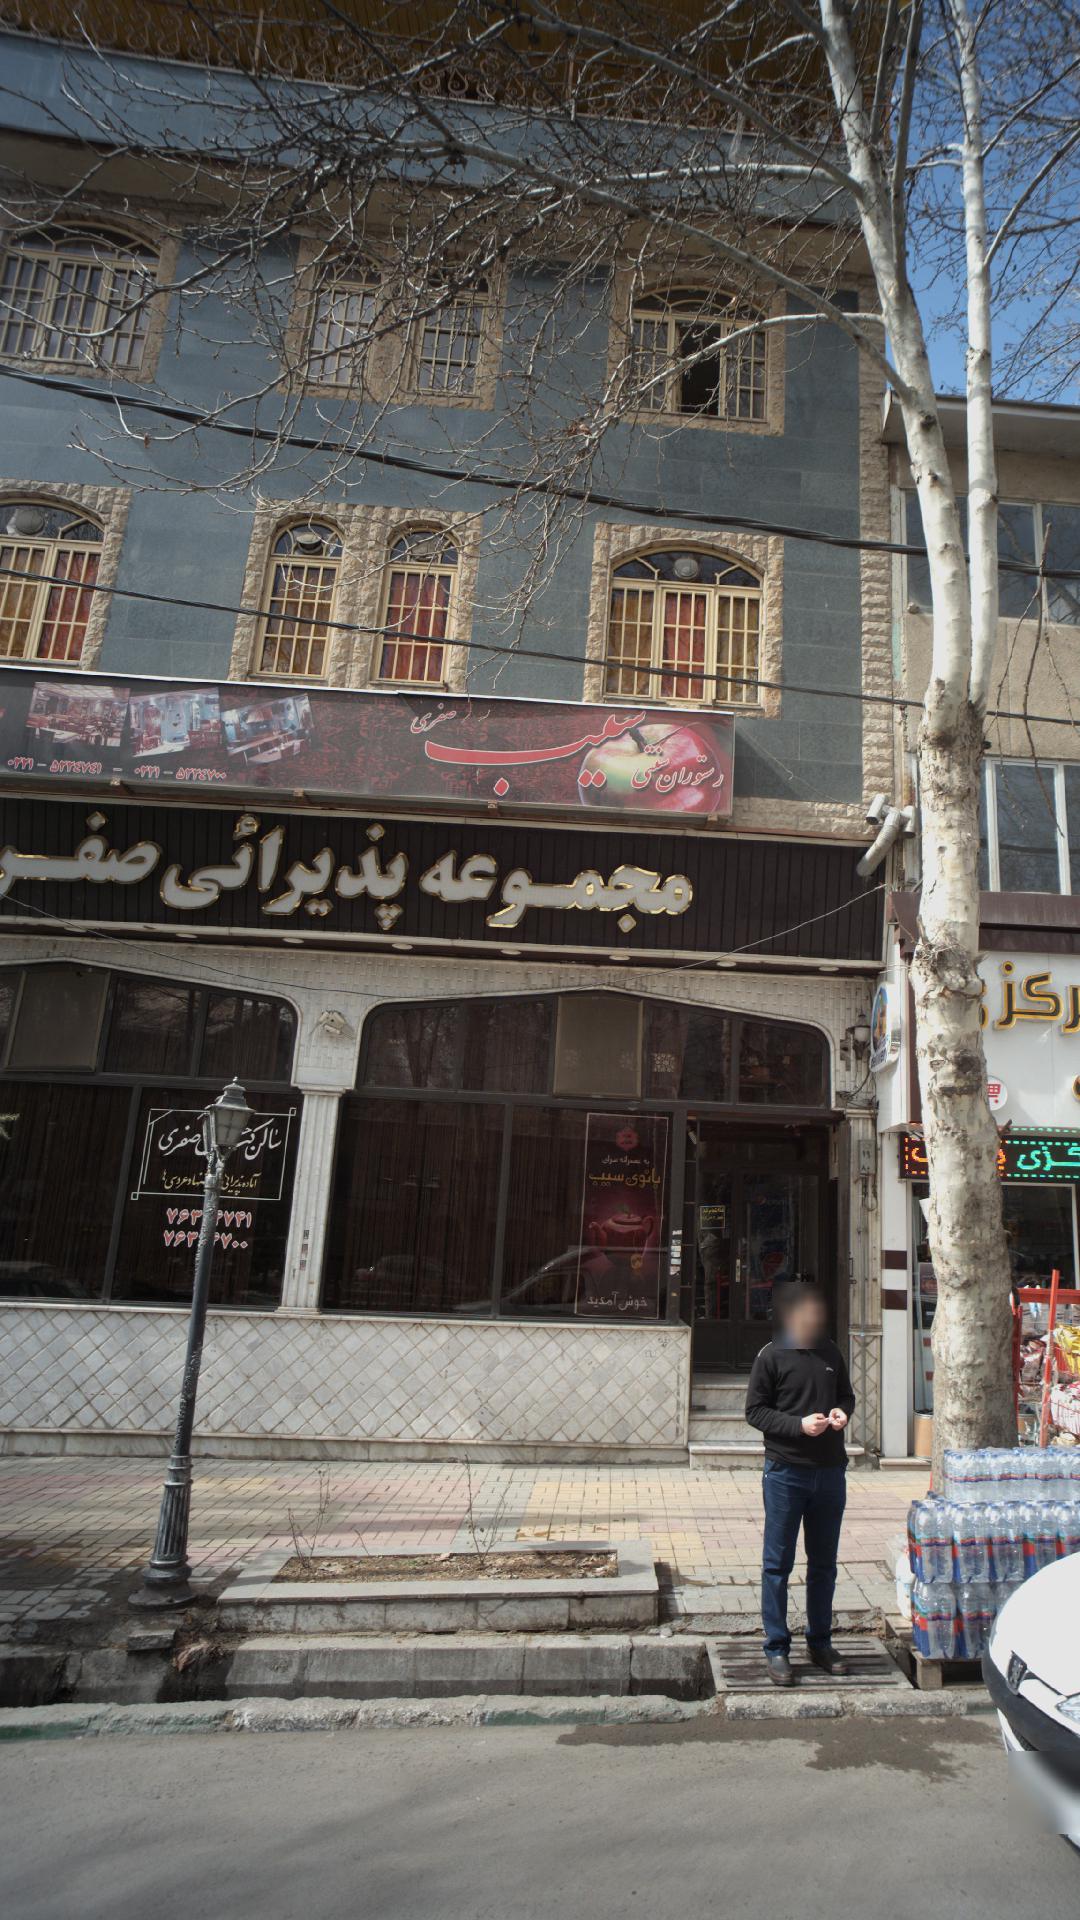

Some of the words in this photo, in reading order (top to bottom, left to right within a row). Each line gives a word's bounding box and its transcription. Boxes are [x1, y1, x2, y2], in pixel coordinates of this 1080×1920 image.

[410, 703, 457, 734] صفری
[425, 711, 646, 796] سیب
[631, 743, 670, 788] سنتی
[655, 753, 724, 792] رستوران
[419, 853, 693, 932] مجموعه
[158, 1125, 201, 1156] صفری
[588, 1170, 625, 1187] سیب
[625, 1167, 662, 1190] بانوی
[587, 1291, 621, 1308] آمدید
[618, 1295, 649, 1311] خوش
